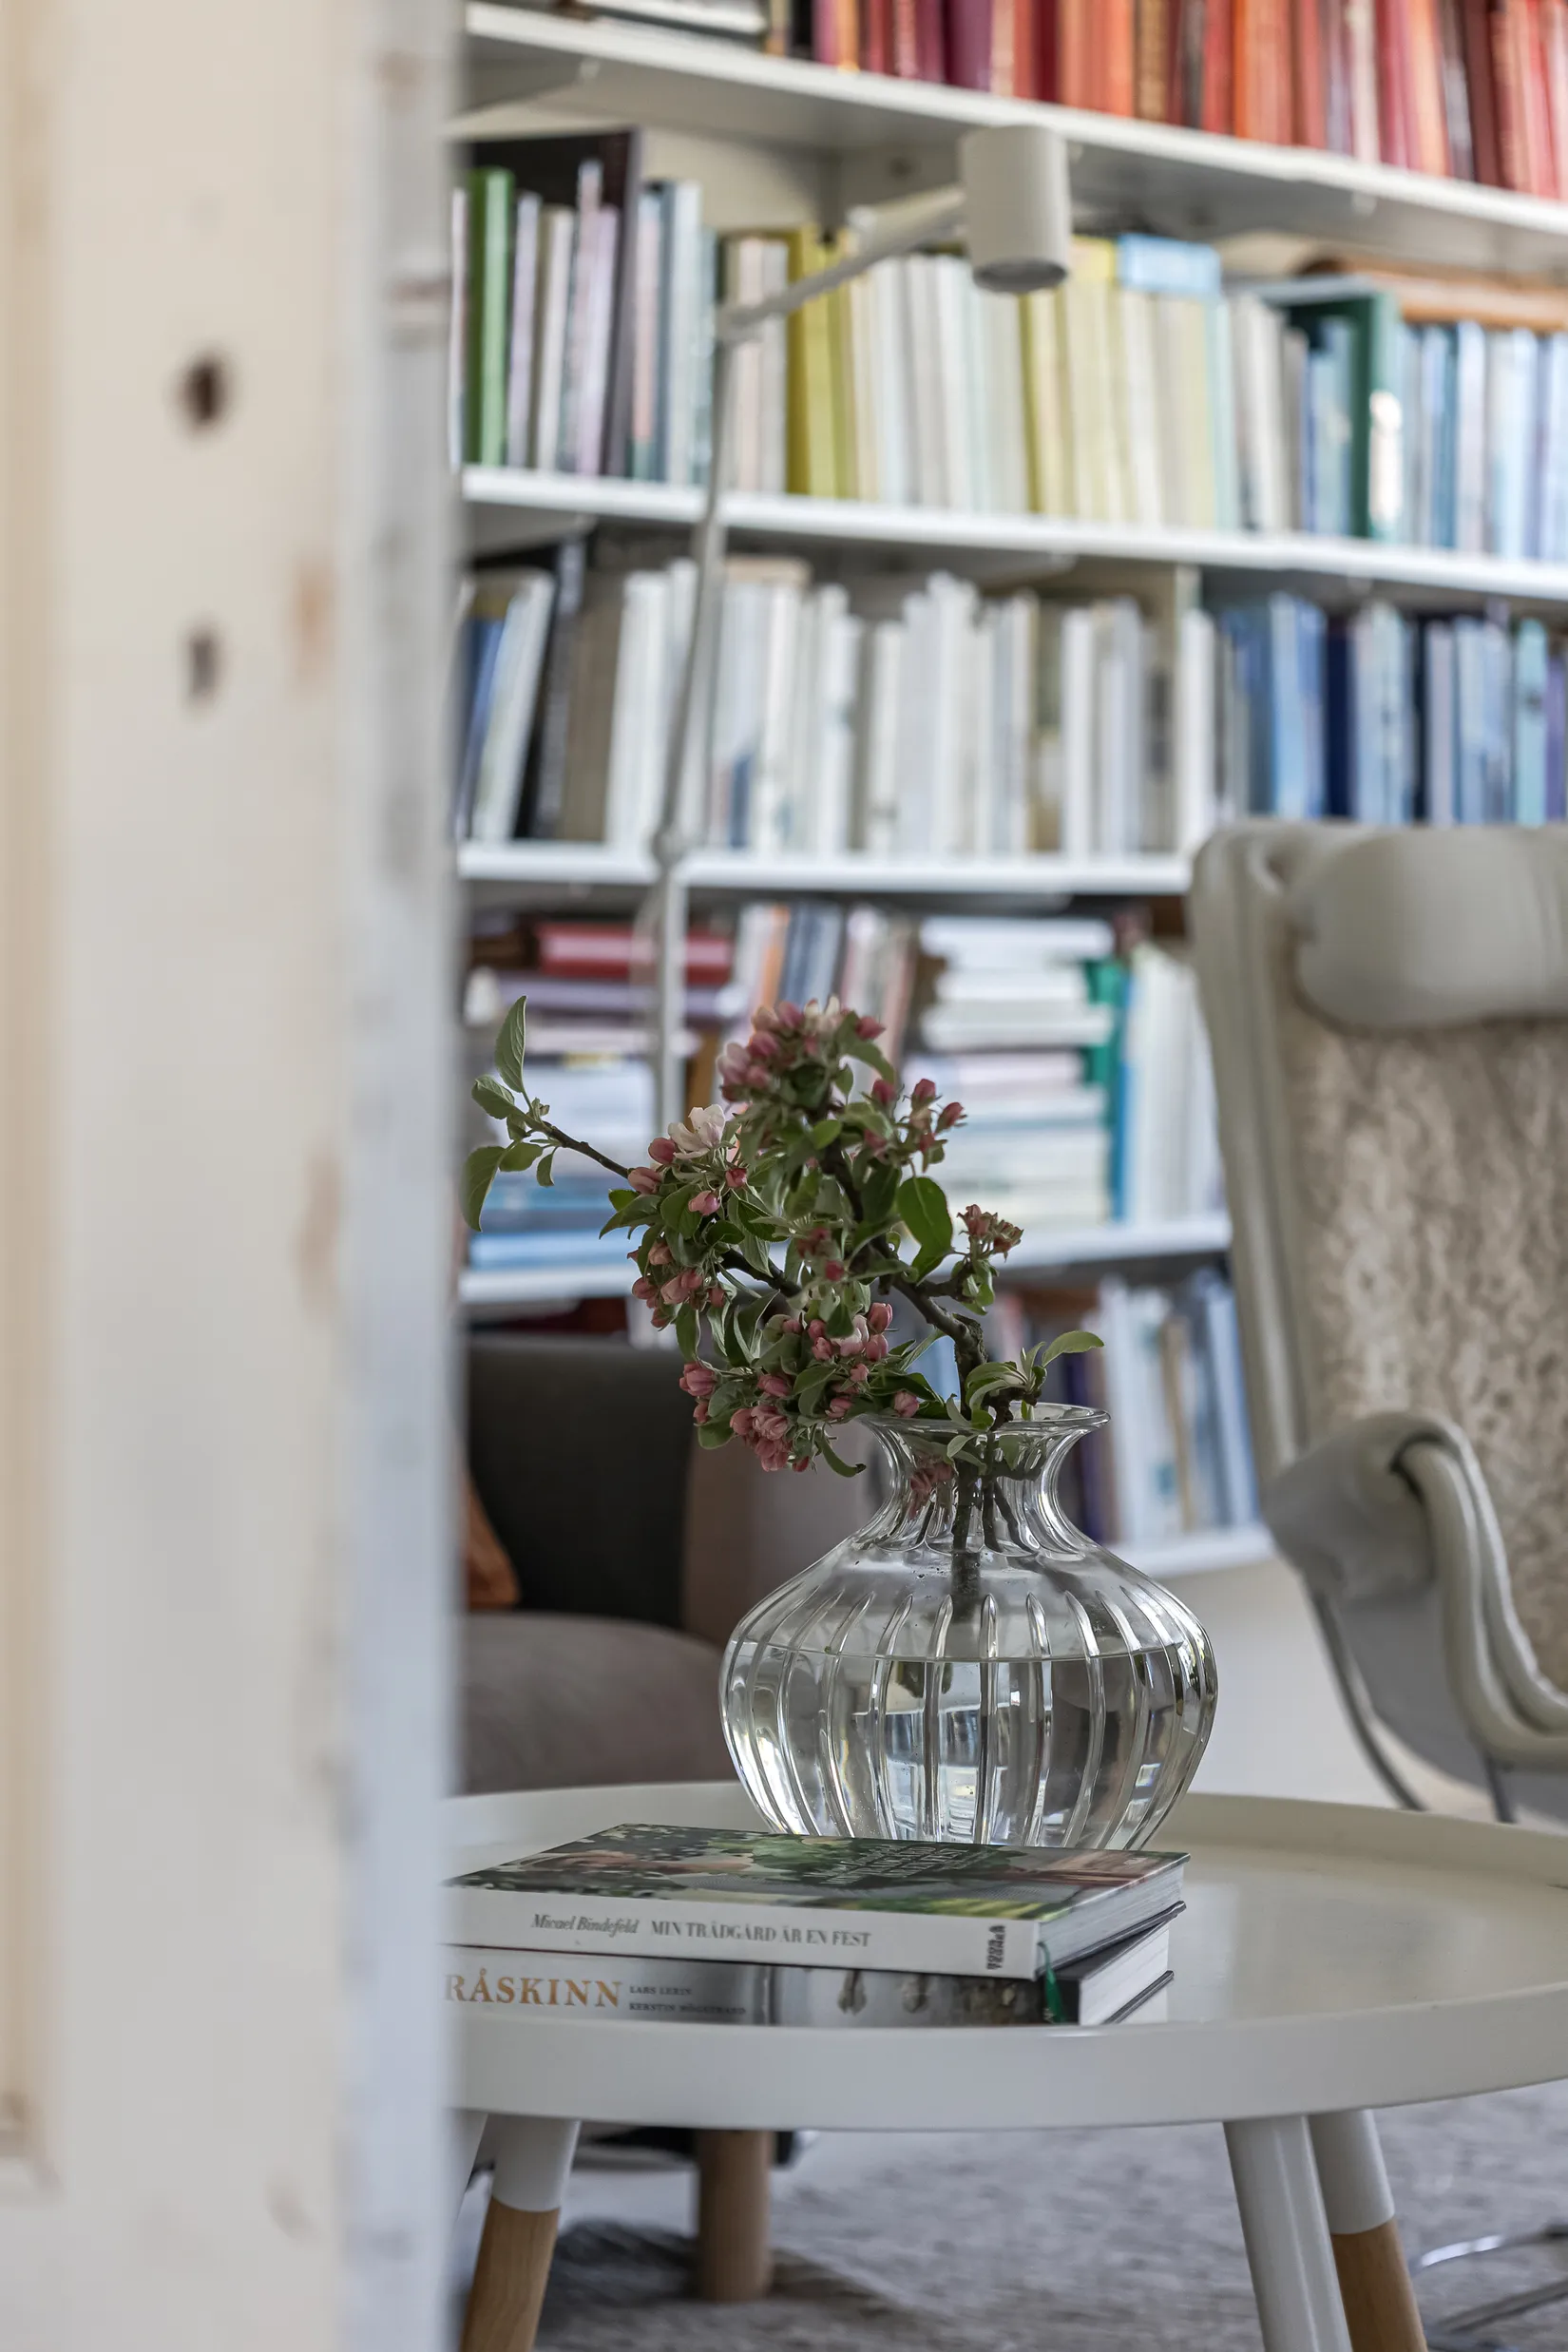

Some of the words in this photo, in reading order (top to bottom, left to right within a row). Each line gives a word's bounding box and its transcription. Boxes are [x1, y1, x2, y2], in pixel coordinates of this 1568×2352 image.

[531, 1913, 576, 1931] Micael
[577, 1915, 641, 1938] Bindefeld
[651, 1920, 682, 1937] MIN
[685, 1920, 777, 1942] TRÄDGÅRD
[779, 1925, 803, 1944] ÄR
[807, 1928, 829, 1945] EN
[832, 1930, 872, 1948] FEST
